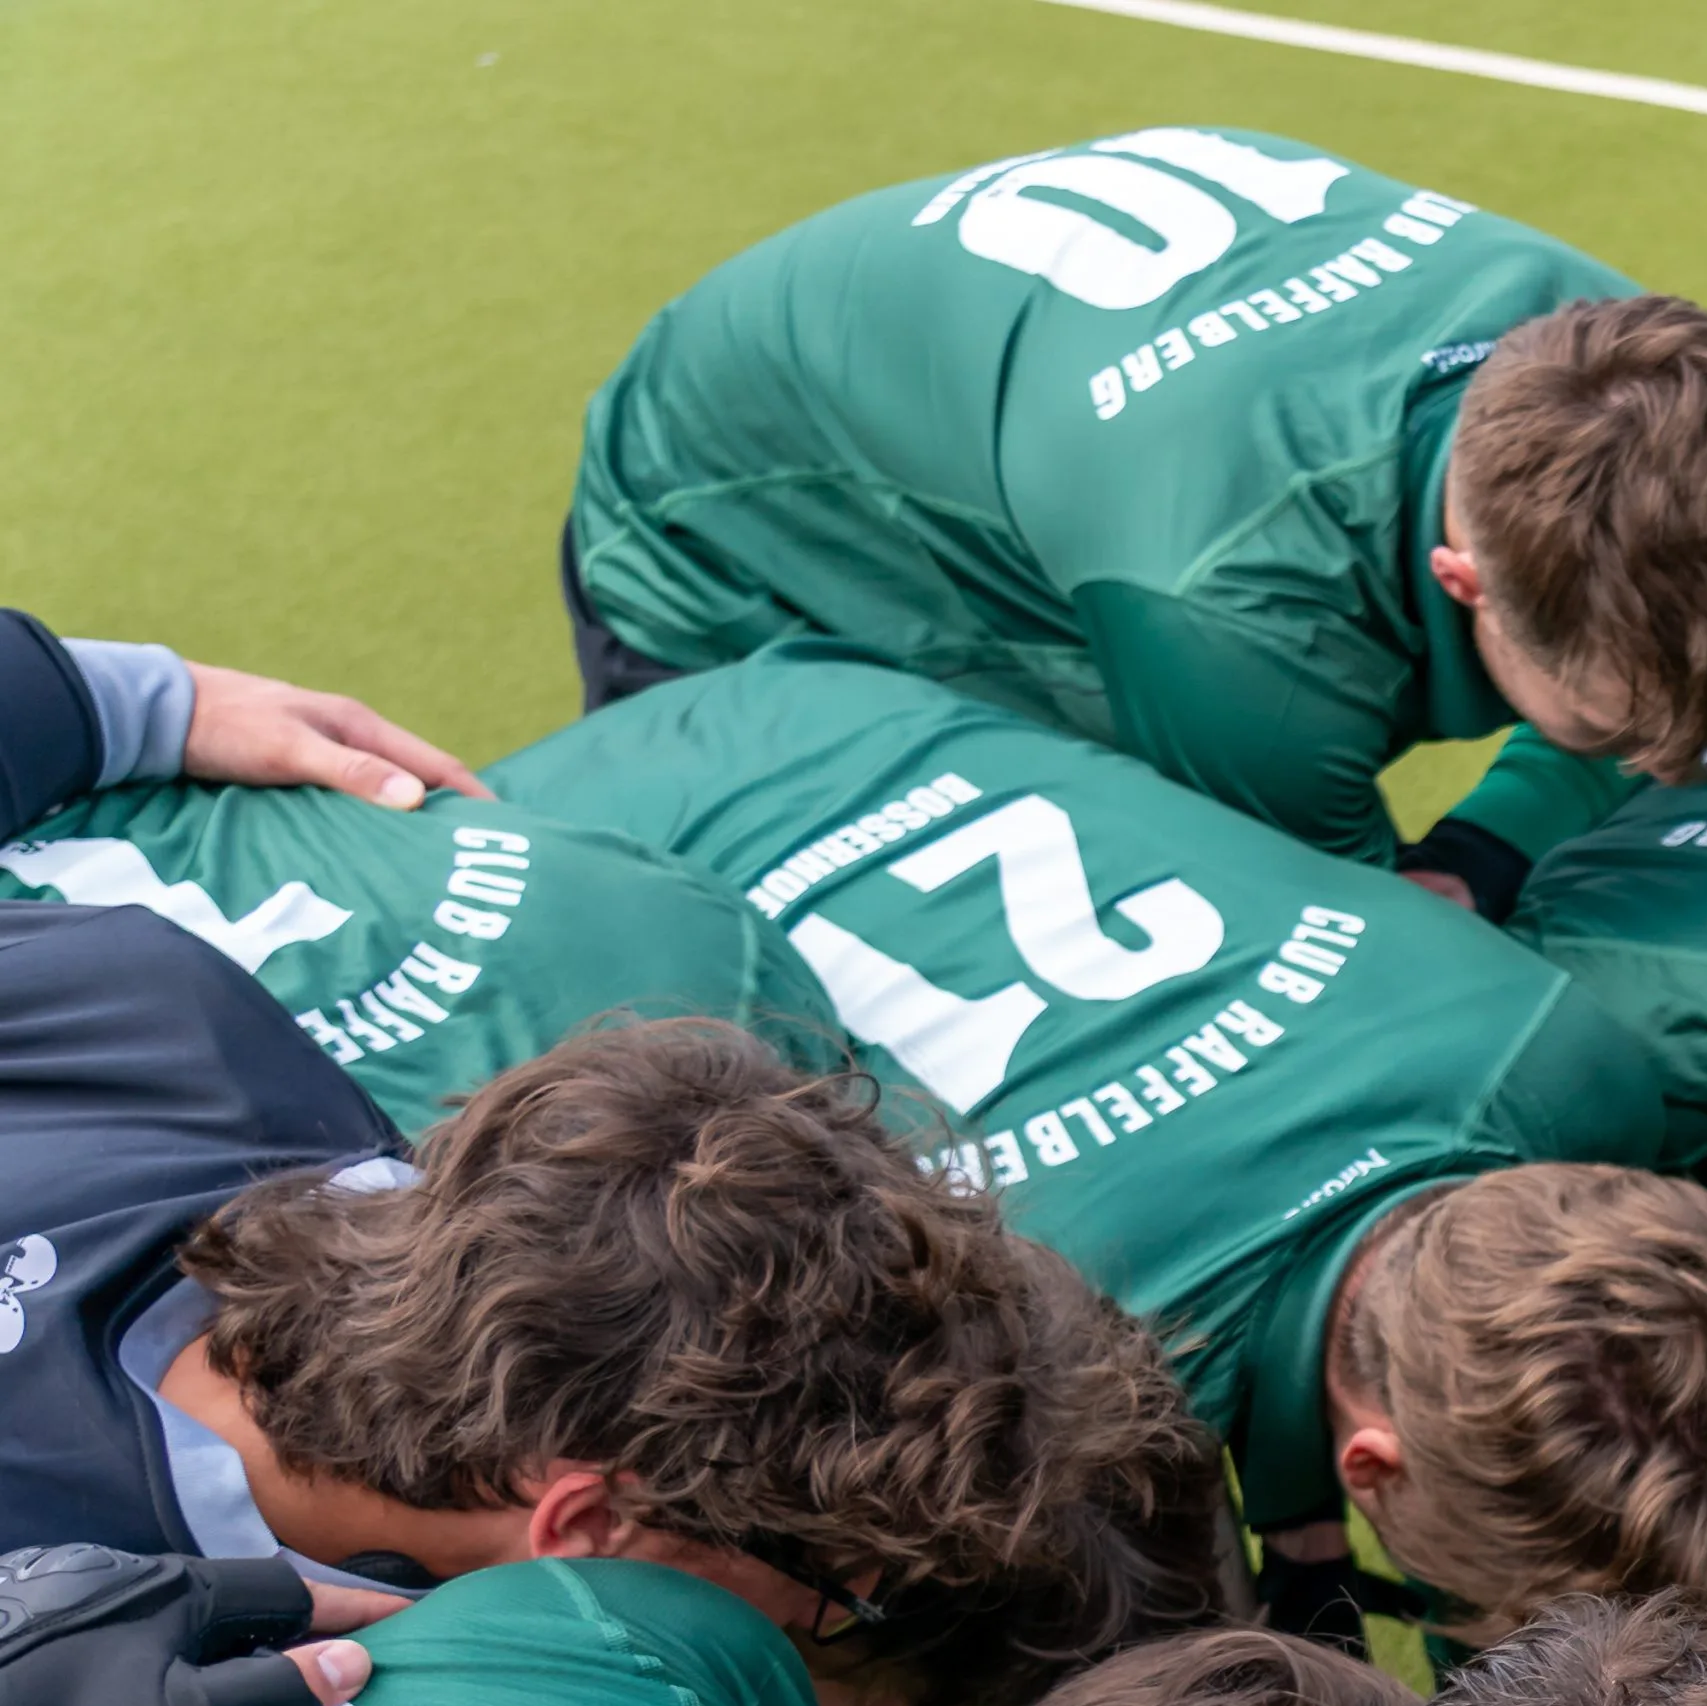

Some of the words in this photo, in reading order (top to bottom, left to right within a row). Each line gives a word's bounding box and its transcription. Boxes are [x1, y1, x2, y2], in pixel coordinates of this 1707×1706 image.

[957, 127, 1350, 310] 10
[1088, 237, 1414, 420] RAFFELBERG
[433, 827, 530, 940] CLUB
[787, 794, 1226, 1116] 21
[1257, 904, 1367, 1004] CLUB
[917, 999, 1286, 1198] RAFFELBER
